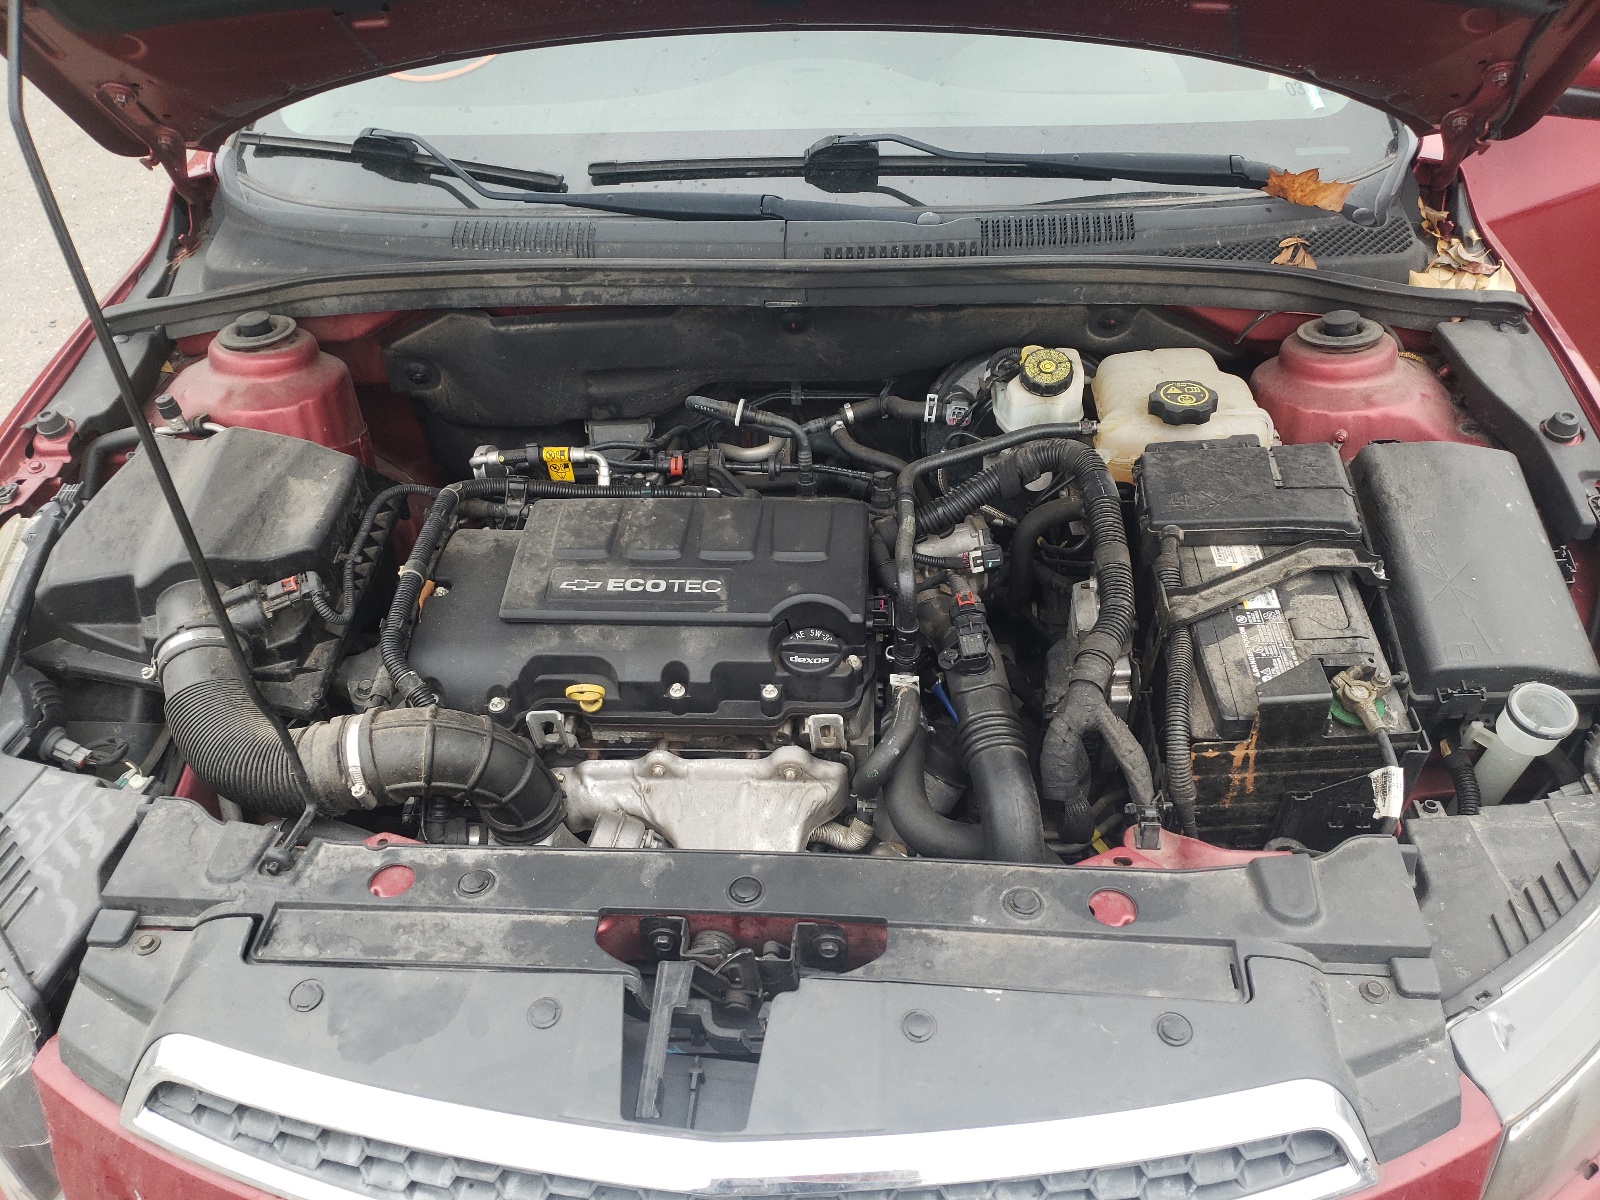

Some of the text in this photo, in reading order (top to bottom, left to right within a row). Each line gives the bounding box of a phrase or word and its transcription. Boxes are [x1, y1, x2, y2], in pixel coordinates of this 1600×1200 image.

[1285, 82, 1306, 96] 03
[607, 578, 722, 593] ECOTEC
[790, 655, 830, 664] dexos
